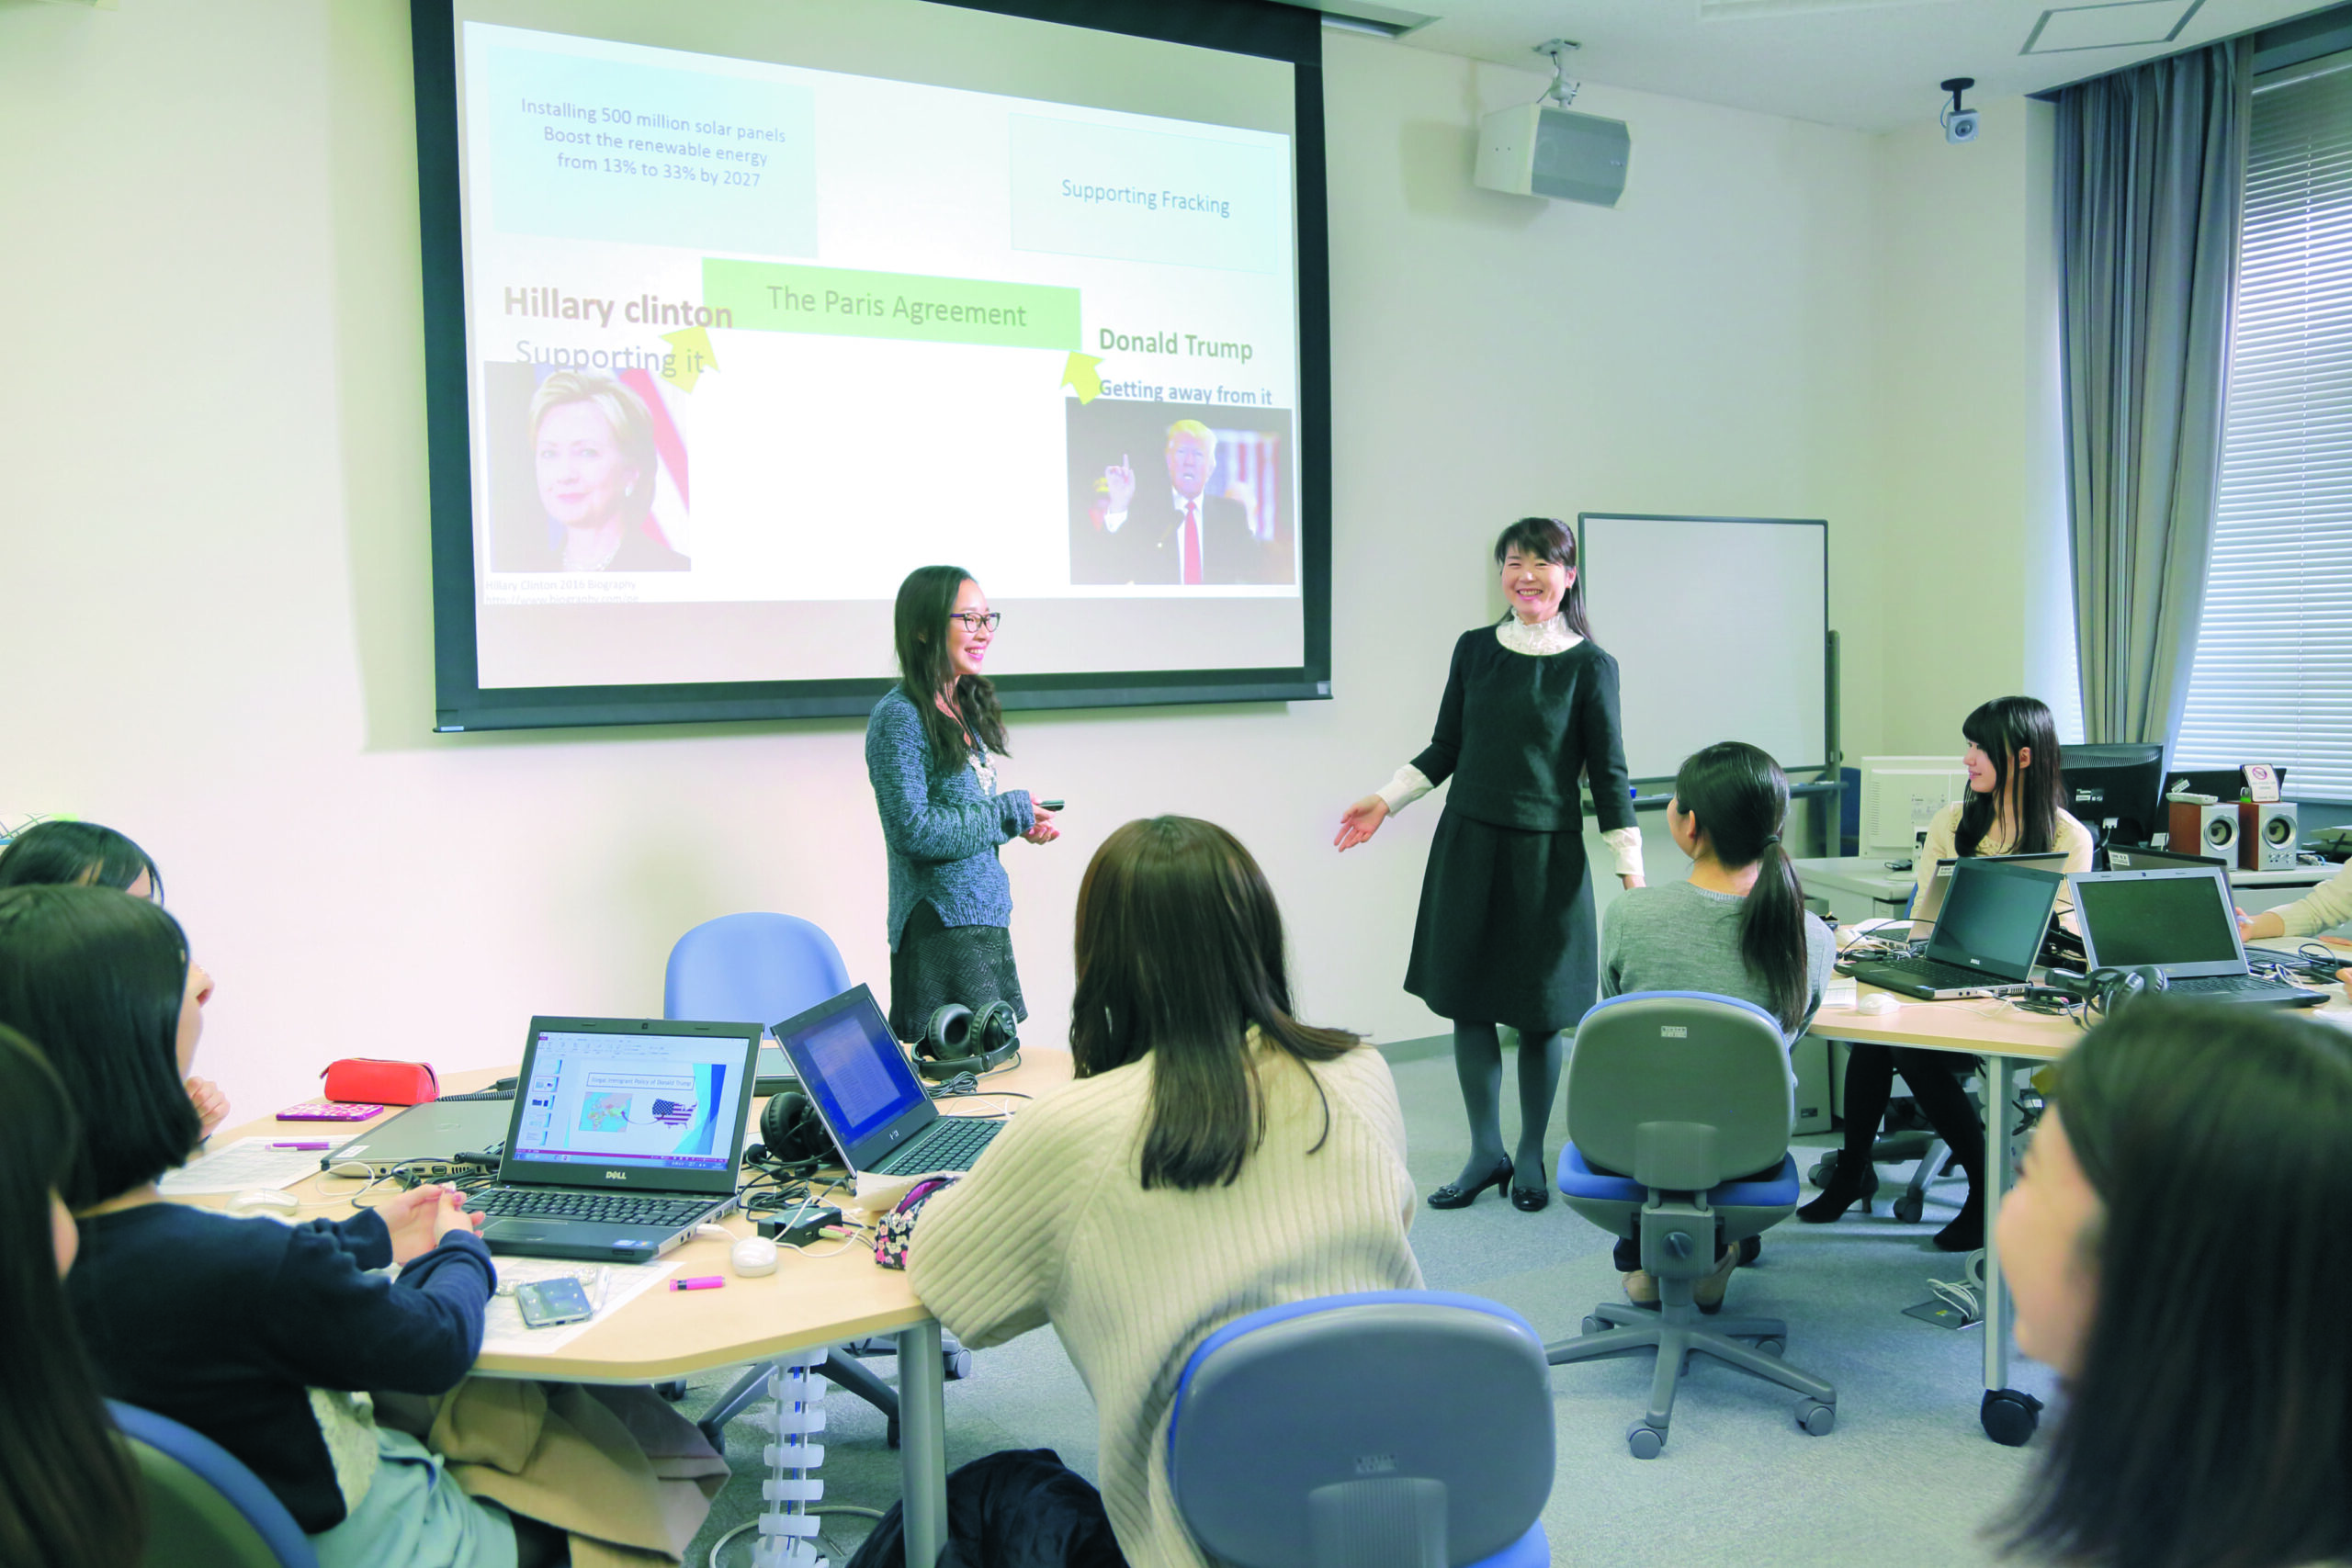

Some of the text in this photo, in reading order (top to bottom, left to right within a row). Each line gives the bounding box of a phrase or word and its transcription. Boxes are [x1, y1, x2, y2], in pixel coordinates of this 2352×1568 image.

[522, 97, 786, 143] Installing 500 million solar panels
[544, 126, 768, 168] Boost the renewable energy
[557, 152, 761, 187] from 13% to 33% by 2027
[1062, 178, 1230, 219] Supporting Fracking
[504, 286, 733, 329] Hillary clinton
[766, 285, 1027, 326] The Paris Agreement
[516, 339, 705, 378] Supporting it
[1099, 327, 1253, 365] Donald Trump
[1099, 378, 1272, 405] Getting away from it
[485, 580, 638, 592] Hillary Clinton 2016 Biography
